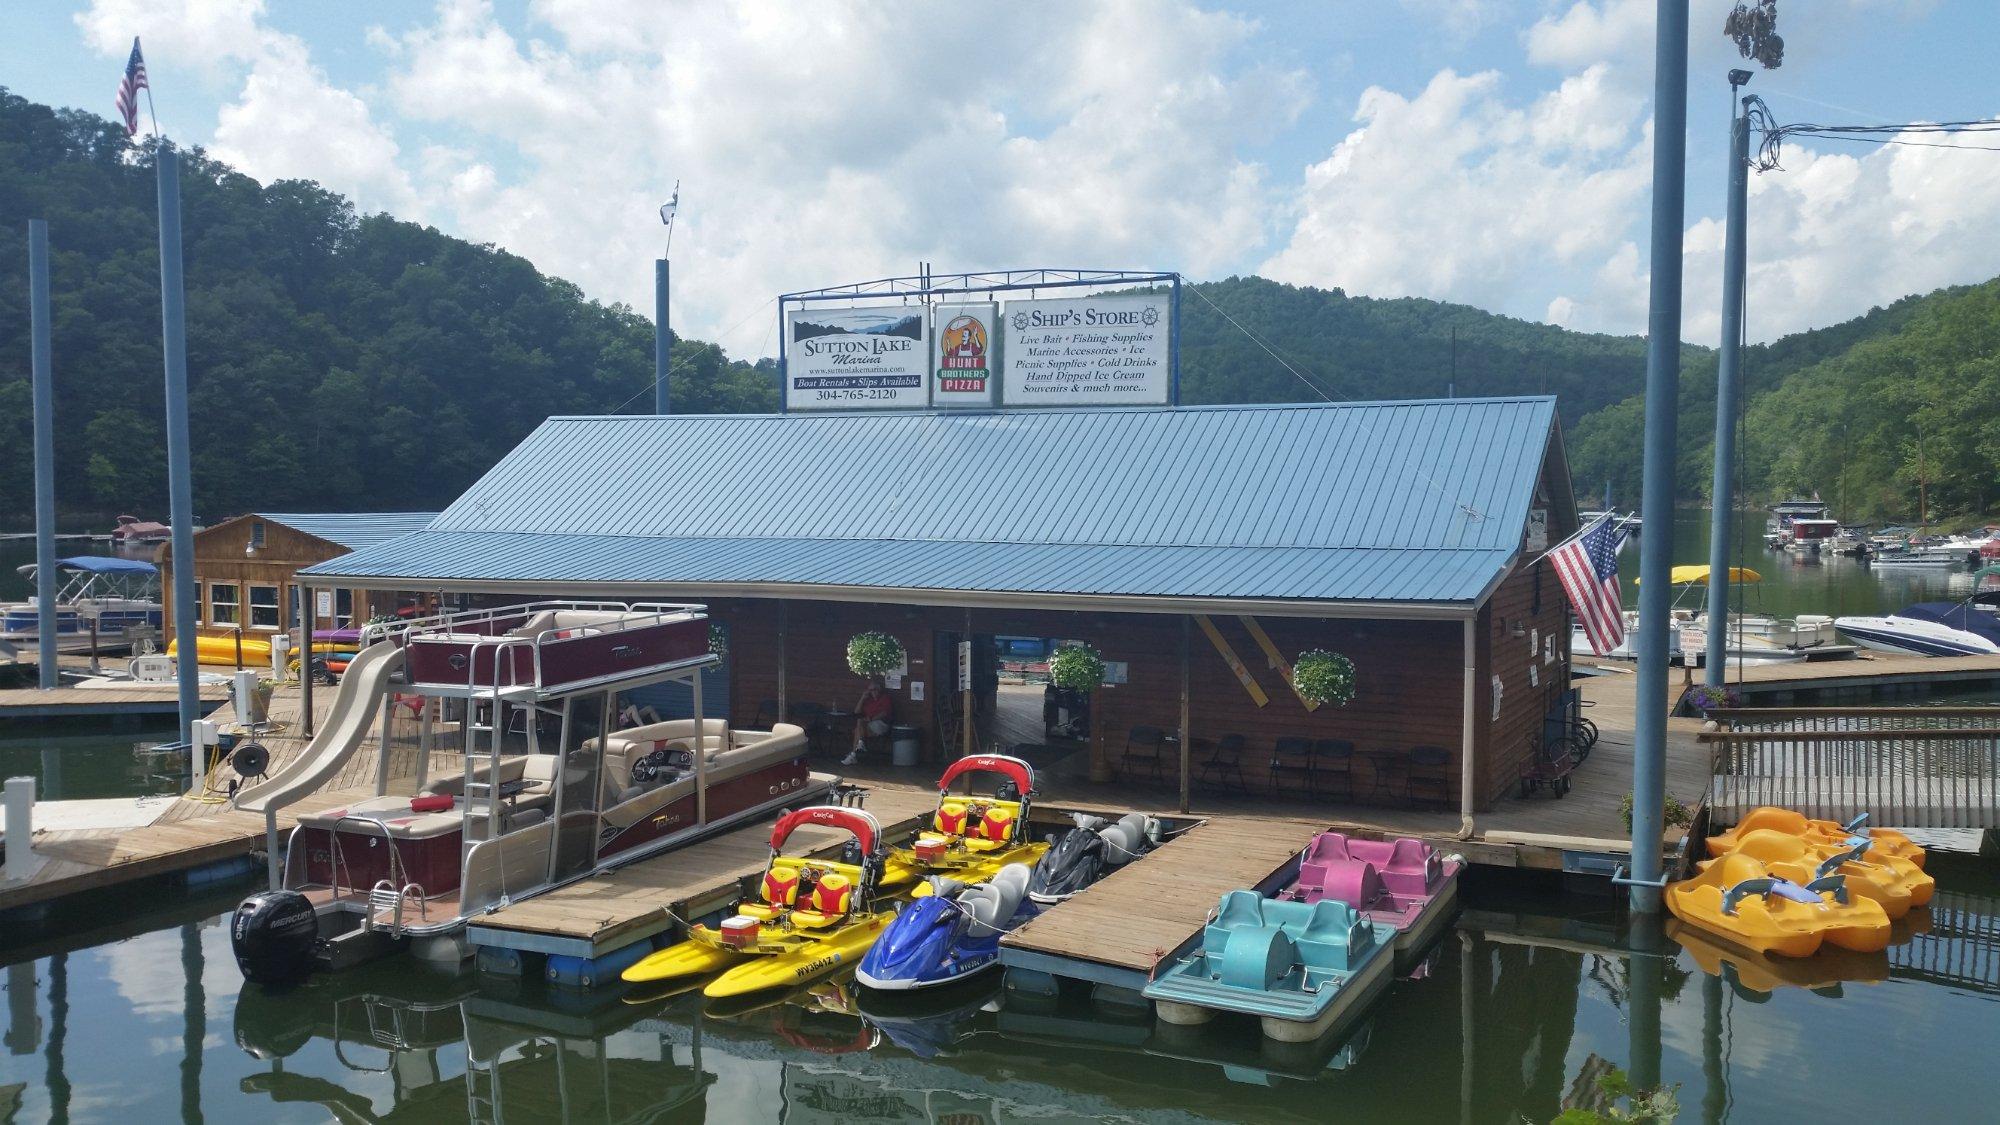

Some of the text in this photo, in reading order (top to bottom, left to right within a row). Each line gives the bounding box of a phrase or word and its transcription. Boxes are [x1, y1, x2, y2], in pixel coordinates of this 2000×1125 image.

[1031, 308, 1139, 327] SHIP'S STORE
[1020, 332, 1153, 345] Live Bait Fishing Supplies
[805, 338, 911, 357] SUTTON LAKE
[1027, 345, 1145, 357] Marine Accessories Ice
[832, 354, 881, 365] Marina
[949, 357, 979, 368] HUNT
[1015, 357, 1157, 371] Picnic Supplies Cold Drinks
[809, 366, 905, 375] www.suttonlakemarina.com
[941, 370, 985, 378] BROTHERS
[1026, 370, 1145, 383] Hand Dipped Ice Cream
[798, 376, 919, 388] Boat Rentals Slips Available
[946, 379, 980, 390] PIZZA
[1022, 383, 1147, 394] Souvenirs & much more...
[816, 389, 897, 401] 304-765-2120
[270, 909, 312, 929] MERCURY
